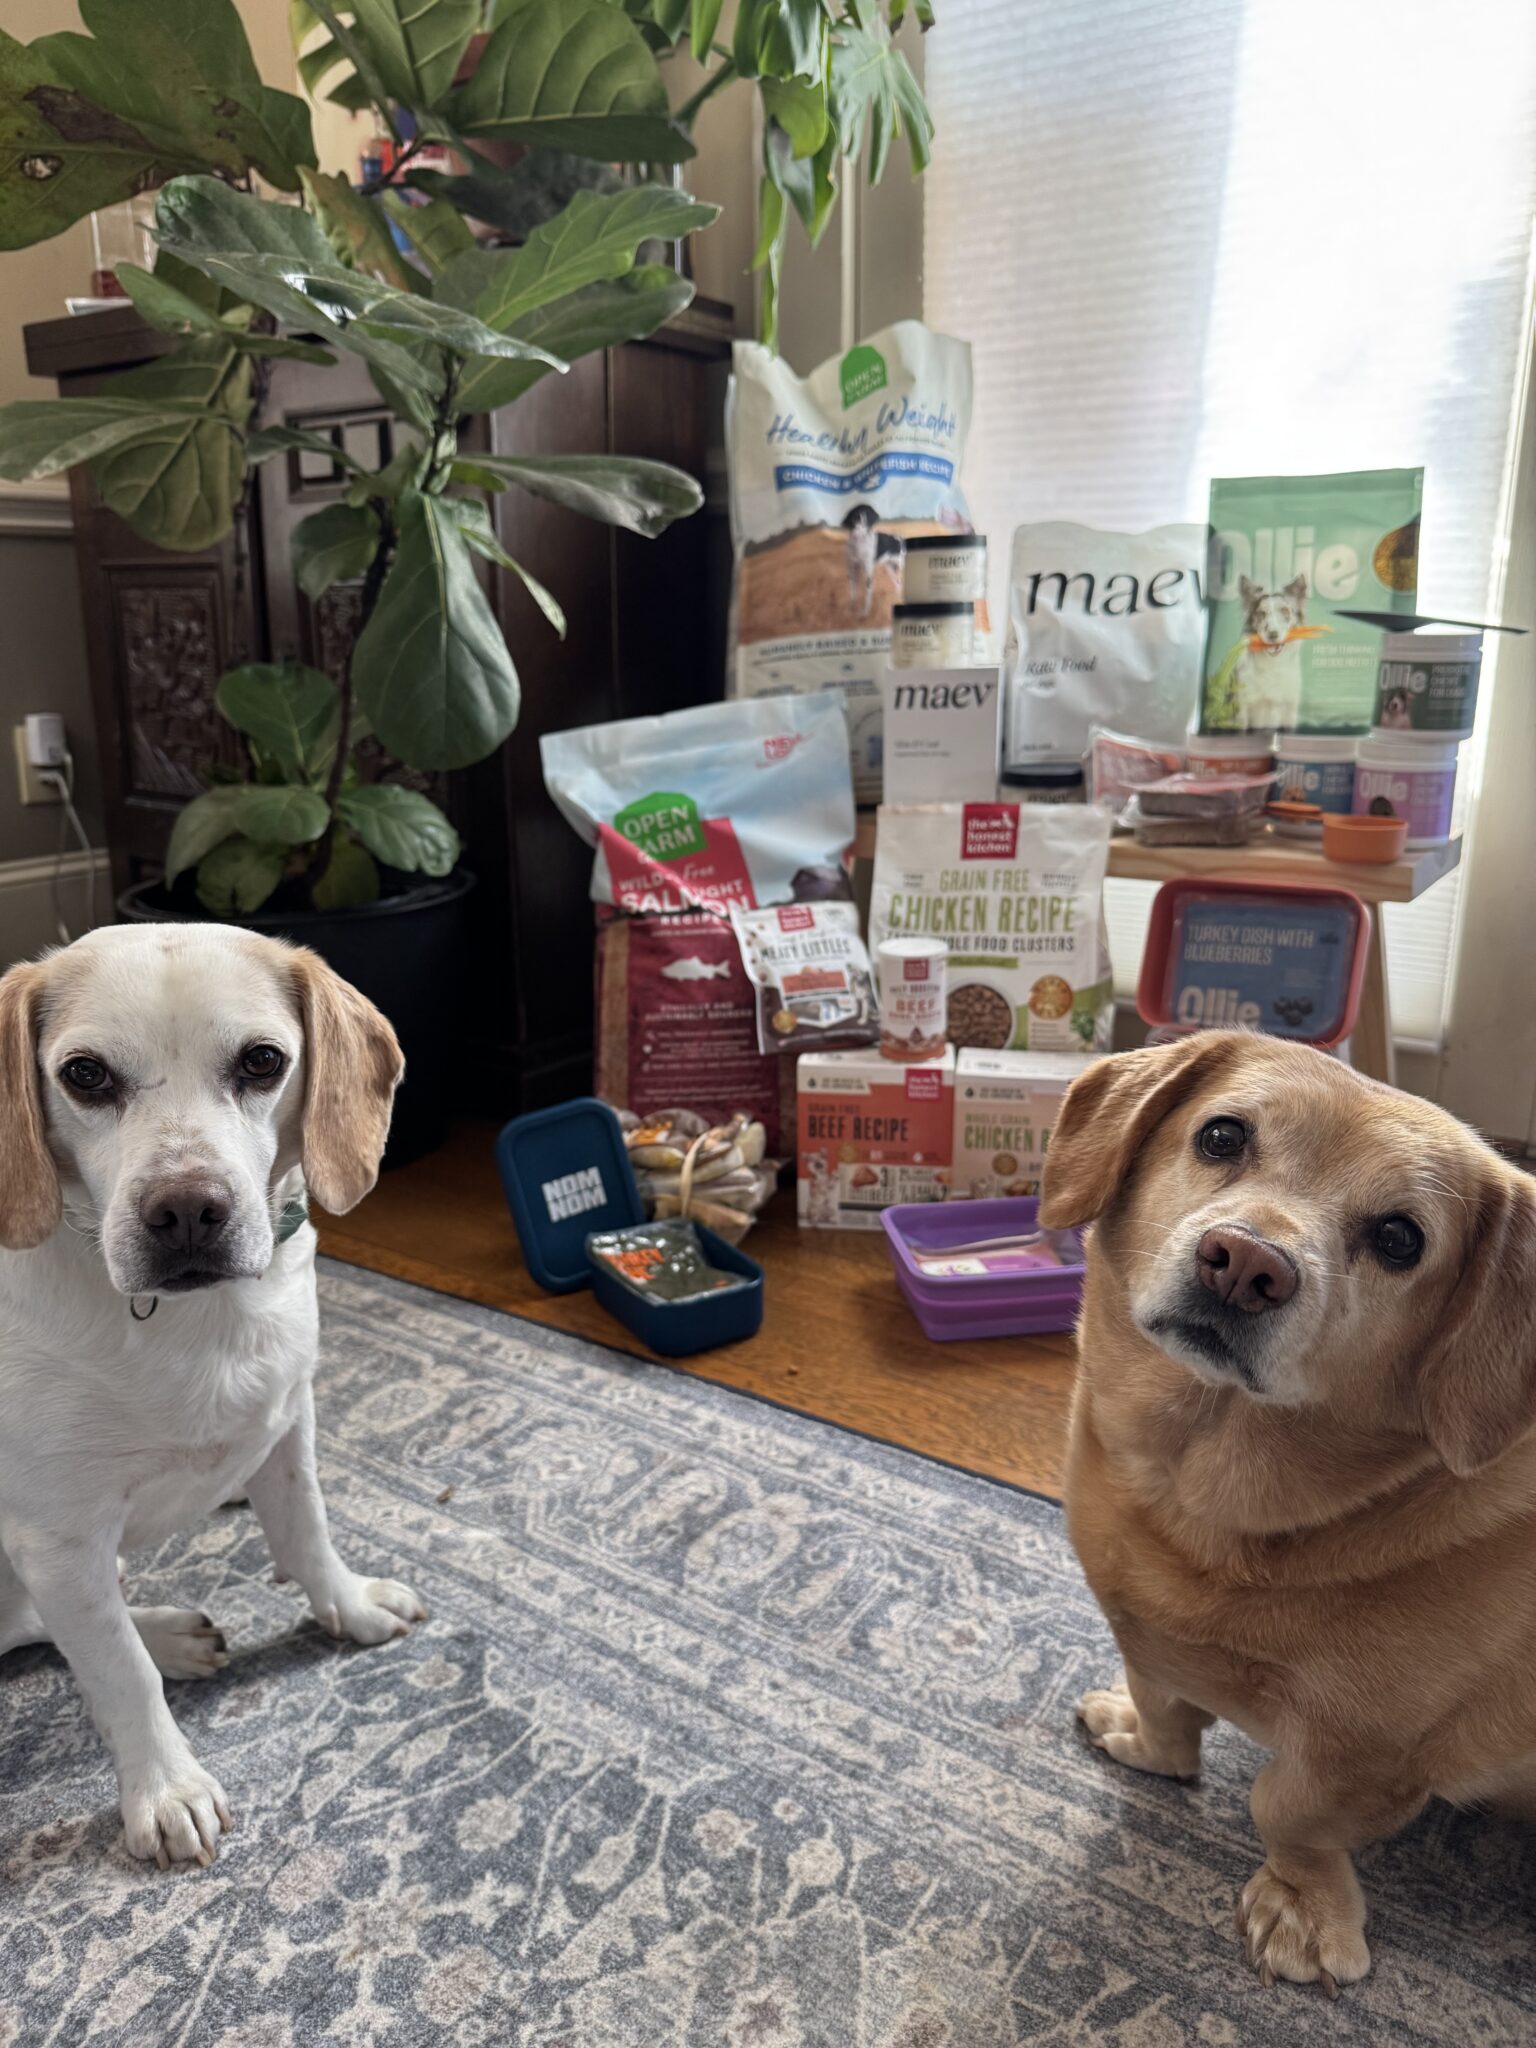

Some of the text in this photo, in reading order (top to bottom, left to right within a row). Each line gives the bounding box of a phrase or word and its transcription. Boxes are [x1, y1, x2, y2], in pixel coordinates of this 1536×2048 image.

[876, 395, 956, 440] Weight
[1208, 525, 1359, 601] Ollie
[1380, 663, 1427, 693] Ollie
[894, 681, 993, 711] maev
[1358, 772, 1408, 800] Ollie
[623, 804, 689, 838] OPEN
[939, 869, 988, 893] GRAIN
[992, 869, 1030, 892] FREE
[888, 894, 1079, 933] CHICKEN RECIPE
[974, 936, 1009, 951] FOOD
[1012, 936, 1074, 952] CLUSTERS
[1187, 924, 1315, 948] TURKEY DISH WITH
[1184, 943, 1274, 966] BLUEBERRIES
[1176, 985, 1260, 1028] Ollie
[807, 1115, 909, 1142] BEEF RECIPE
[964, 1125, 1034, 1153] CHICKEN
[542, 1165, 600, 1201] NOM
[549, 1186, 608, 1223] NOM
